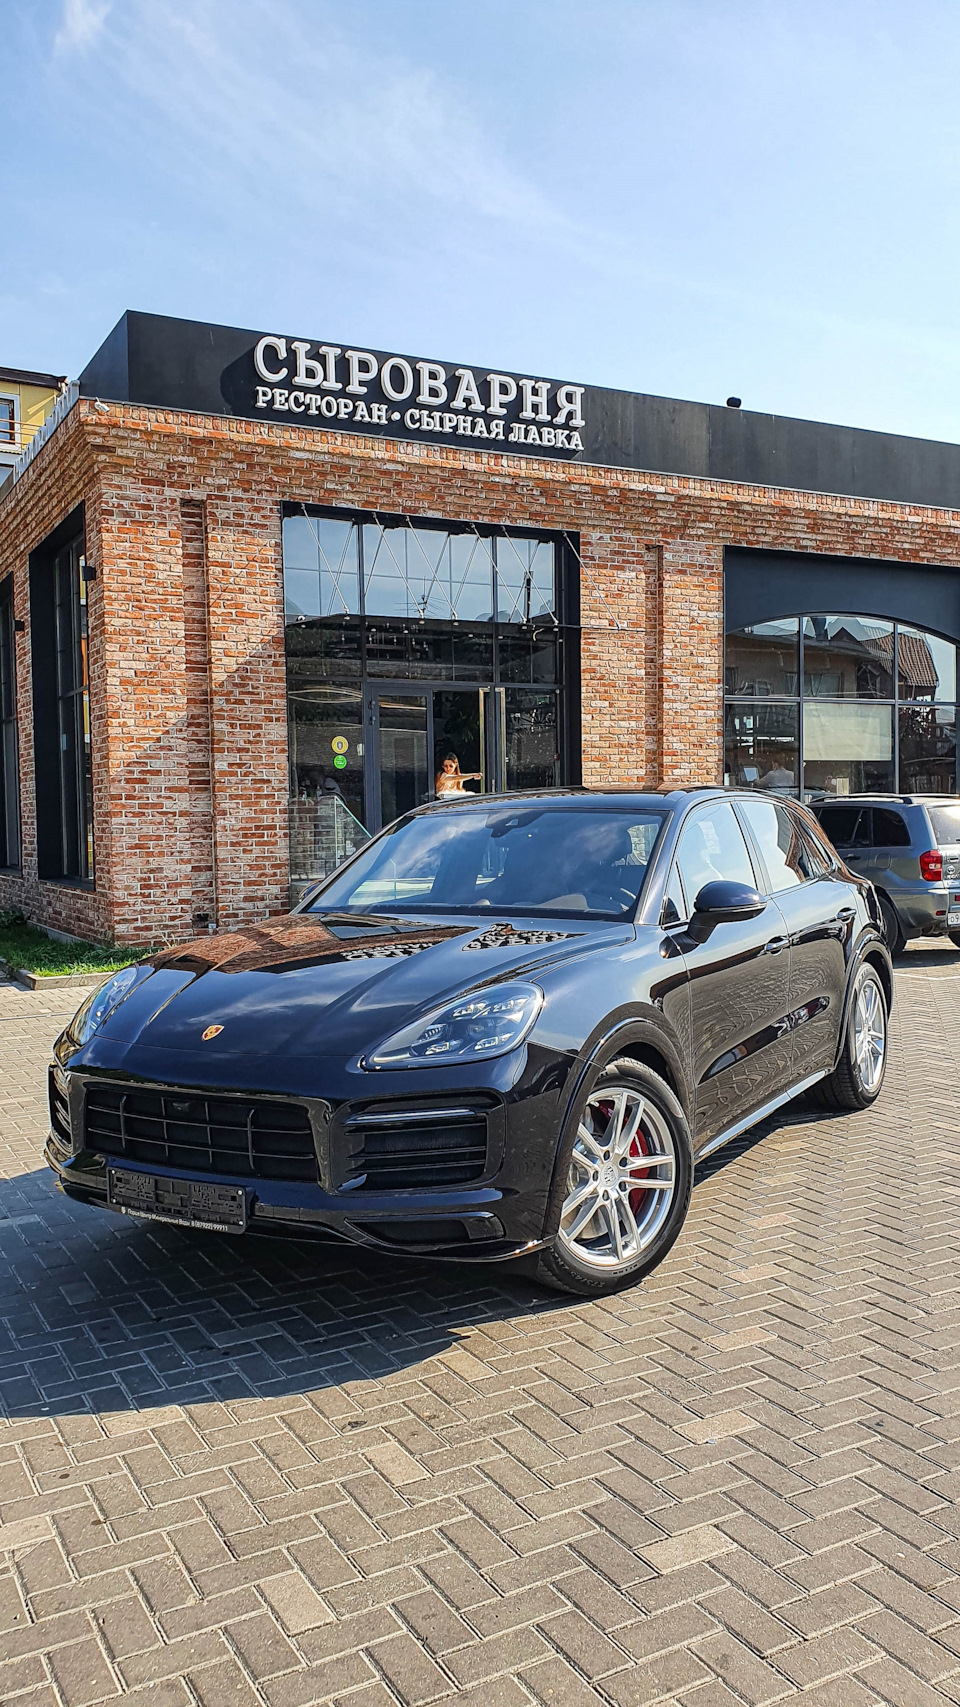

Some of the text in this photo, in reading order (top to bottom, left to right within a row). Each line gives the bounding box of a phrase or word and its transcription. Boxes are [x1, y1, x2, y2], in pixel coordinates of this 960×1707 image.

[254, 335, 586, 427] СЫРОВАРНЯ
[254, 386, 584, 451] РЕСТОРАН СЫРНАЯ ЛАВКА
